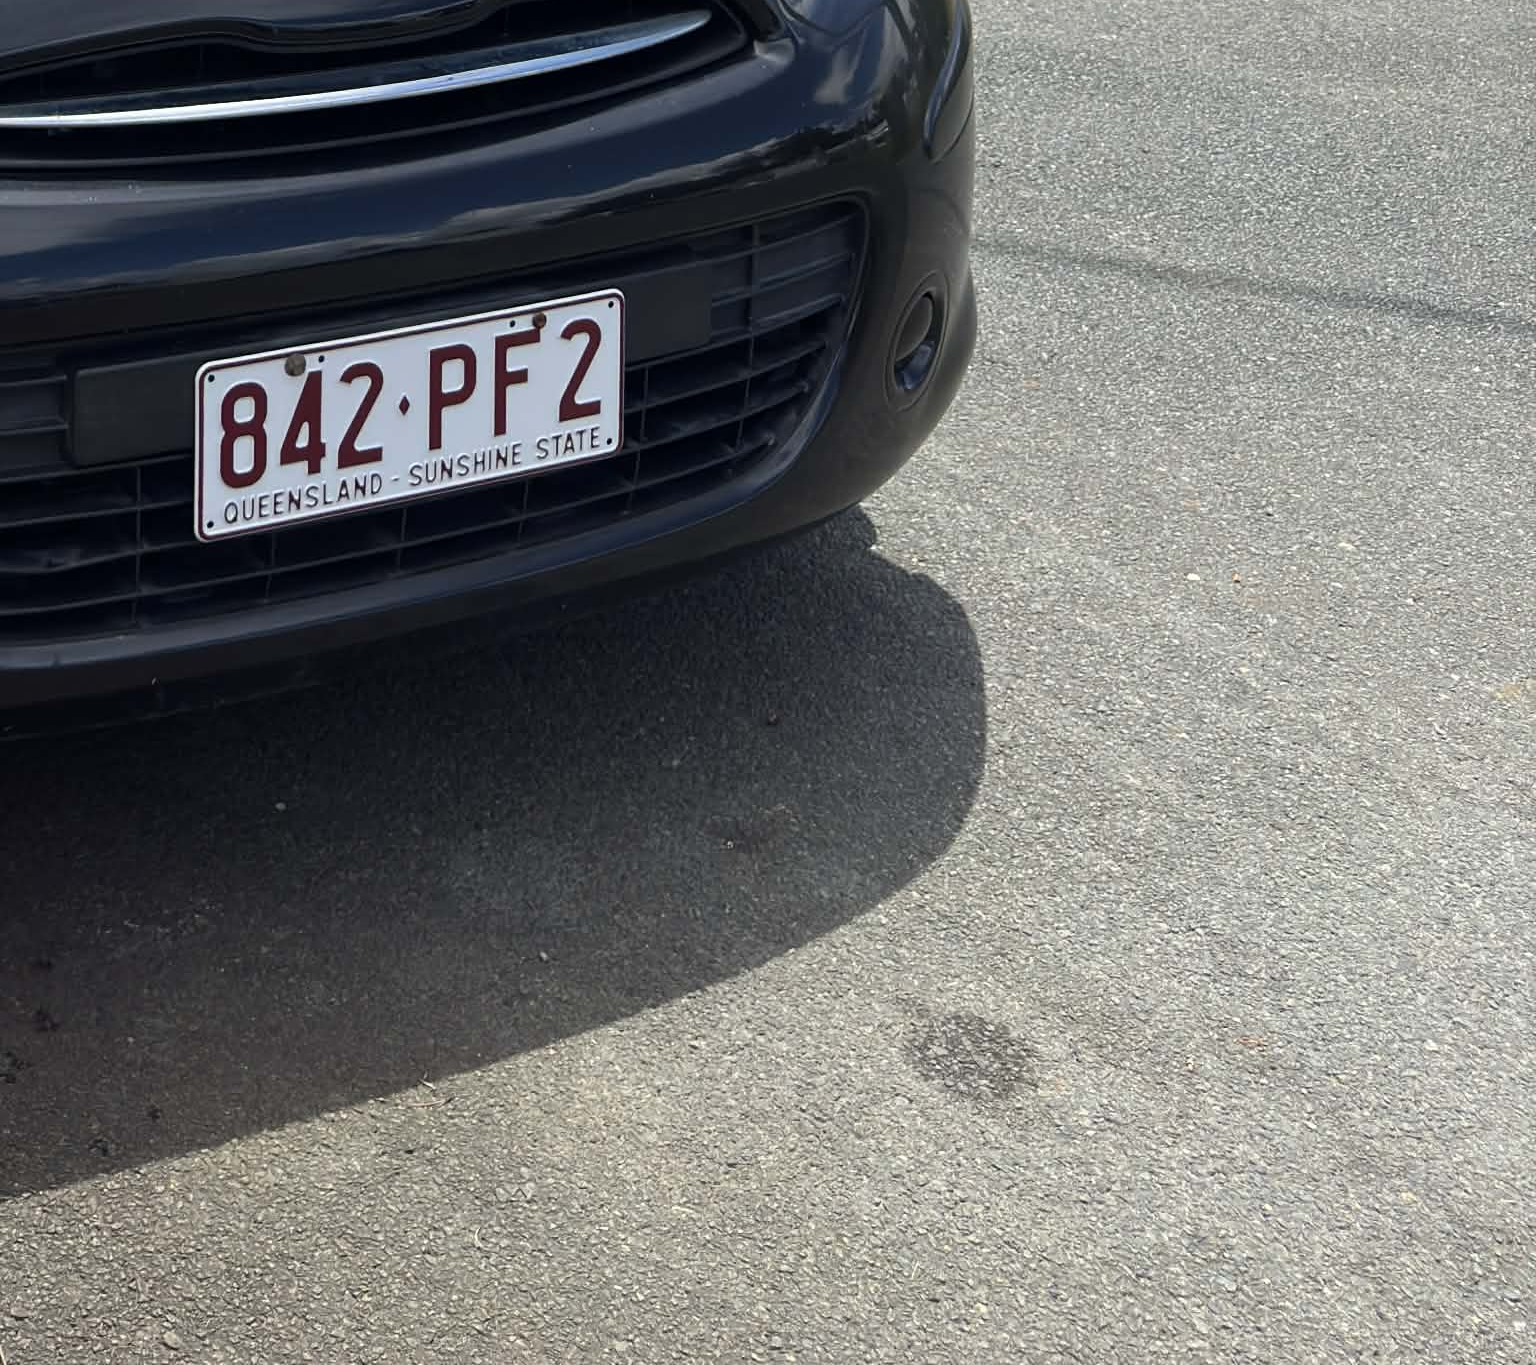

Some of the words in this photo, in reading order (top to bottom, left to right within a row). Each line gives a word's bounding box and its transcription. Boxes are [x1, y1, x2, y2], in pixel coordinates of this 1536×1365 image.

[224, 472, 383, 524] QUEENSLAND
[408, 442, 523, 487] SUNSHINE
[535, 426, 601, 460] STATE
